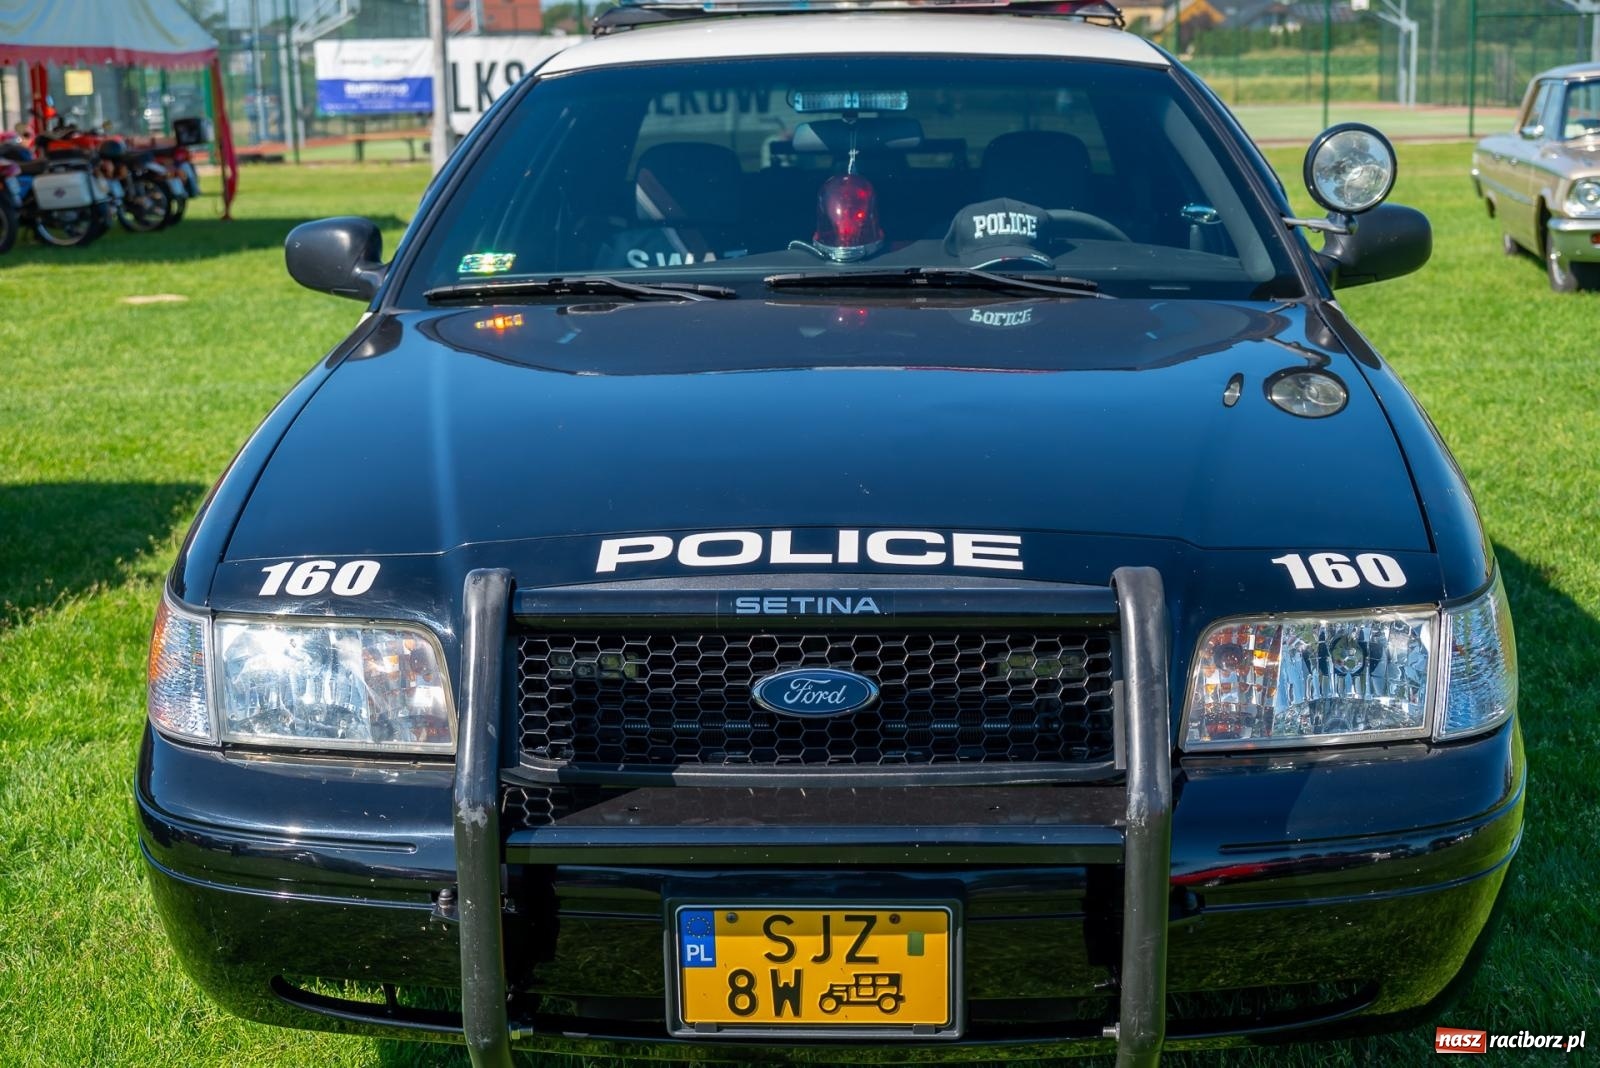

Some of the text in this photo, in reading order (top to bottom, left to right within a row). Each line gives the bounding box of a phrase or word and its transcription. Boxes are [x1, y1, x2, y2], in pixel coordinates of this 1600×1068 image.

[973, 212, 1038, 239] POLICE
[596, 530, 1024, 573] POLICE
[258, 560, 381, 596] 160
[1271, 553, 1407, 589] 160
[735, 597, 880, 614] SETINA
[783, 679, 846, 706] Ford
[686, 944, 712, 962] PL
[762, 914, 879, 964] SJZ
[727, 969, 803, 1018] 8W
